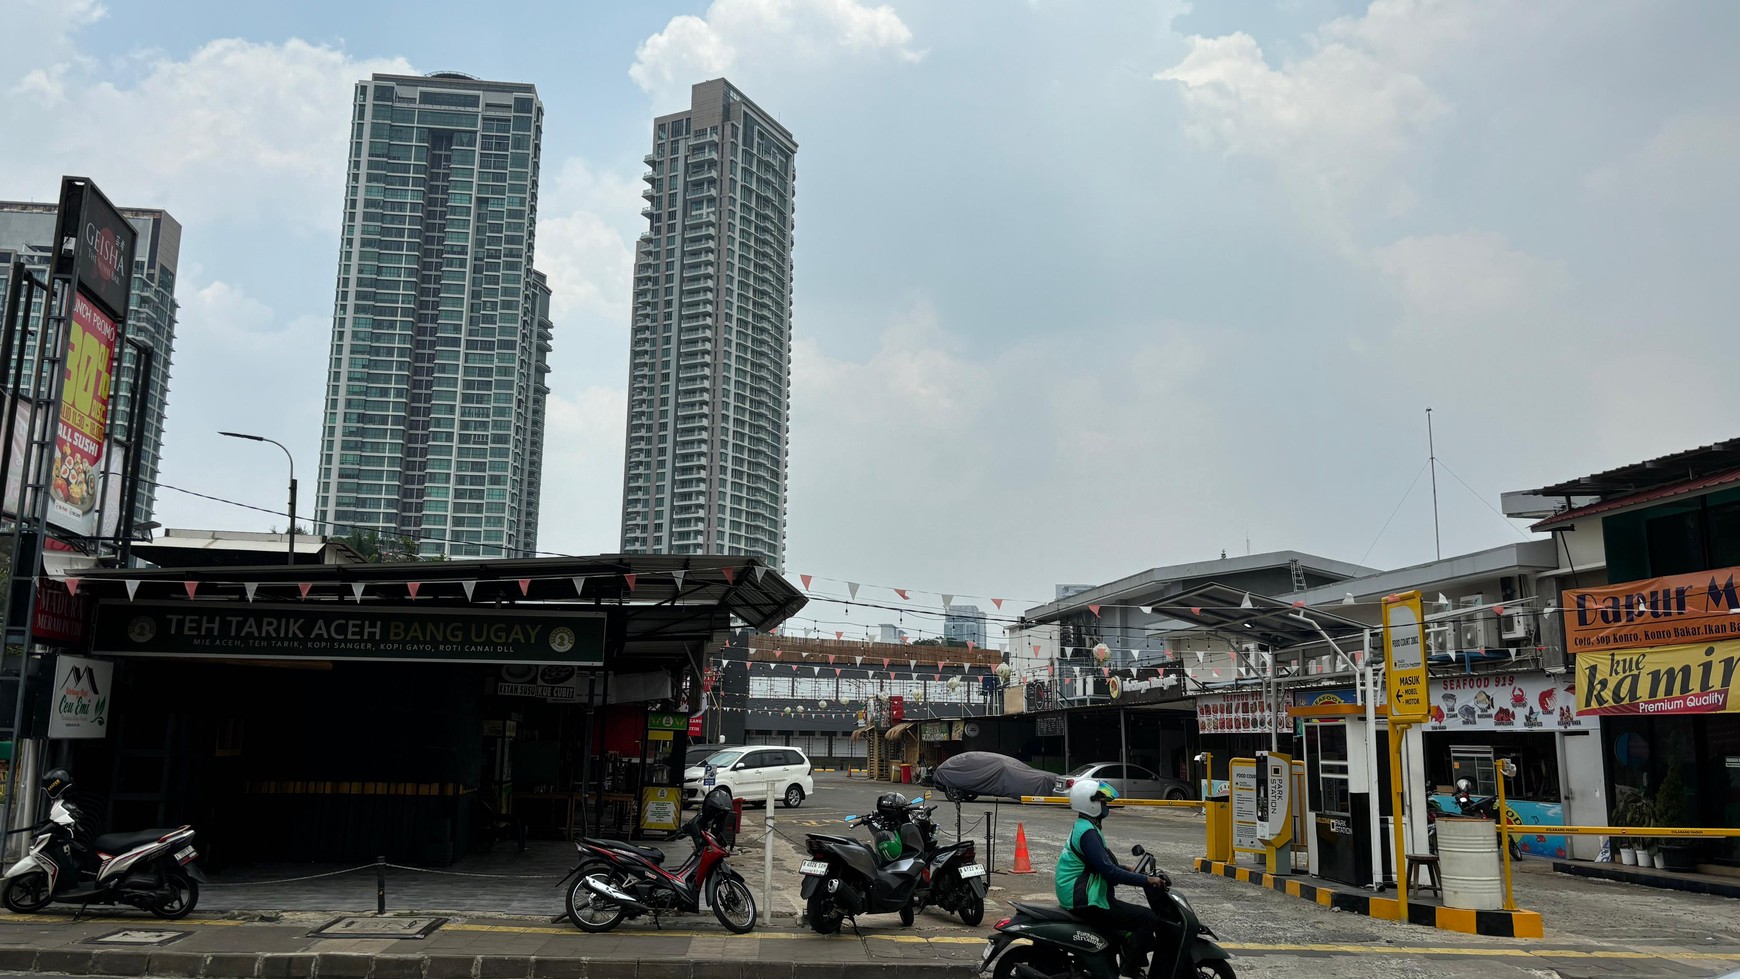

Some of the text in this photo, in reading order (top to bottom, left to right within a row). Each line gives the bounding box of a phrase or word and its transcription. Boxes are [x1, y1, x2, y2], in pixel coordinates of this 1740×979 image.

[86, 222, 124, 277] GEISHA
[88, 248, 96, 264] THE
[111, 271, 120, 286] BAR
[93, 318, 114, 342] PROMO
[58, 422, 98, 457] ALL SUSHI
[40, 588, 84, 619] MADURA
[1576, 584, 1692, 626] Dapur
[38, 613, 62, 632] MERAH
[166, 614, 220, 636] TEH
[226, 616, 305, 638] TARIK
[310, 618, 382, 640] ACEH
[389, 621, 464, 642] BANG
[470, 623, 542, 644] UGAY
[193, 638, 212, 647] MIE
[214, 639, 244, 648] ACEH,
[271, 640, 303, 649] TARIK,
[307, 641, 331, 650] KOPI
[334, 642, 376, 652] SANGER,
[406, 643, 434, 652] GAYO,
[439, 644, 461, 652] ROTI
[465, 645, 494, 653] CANAI
[1613, 633, 1642, 644] Konro,
[1644, 630, 1671, 641] Konro
[1610, 652, 1647, 676] kue
[499, 684, 535, 696] KETAN SUSU
[538, 685, 574, 698] KUE CUBIT
[1400, 676, 1420, 686] MASUK
[1443, 675, 1514, 690] SEAFOOD 919
[59, 694, 91, 715] Ceu Emi
[1222, 694, 1249, 702] SEAFOOD
[1639, 692, 1724, 713] Premium Quality
[705, 766, 712, 775] P
